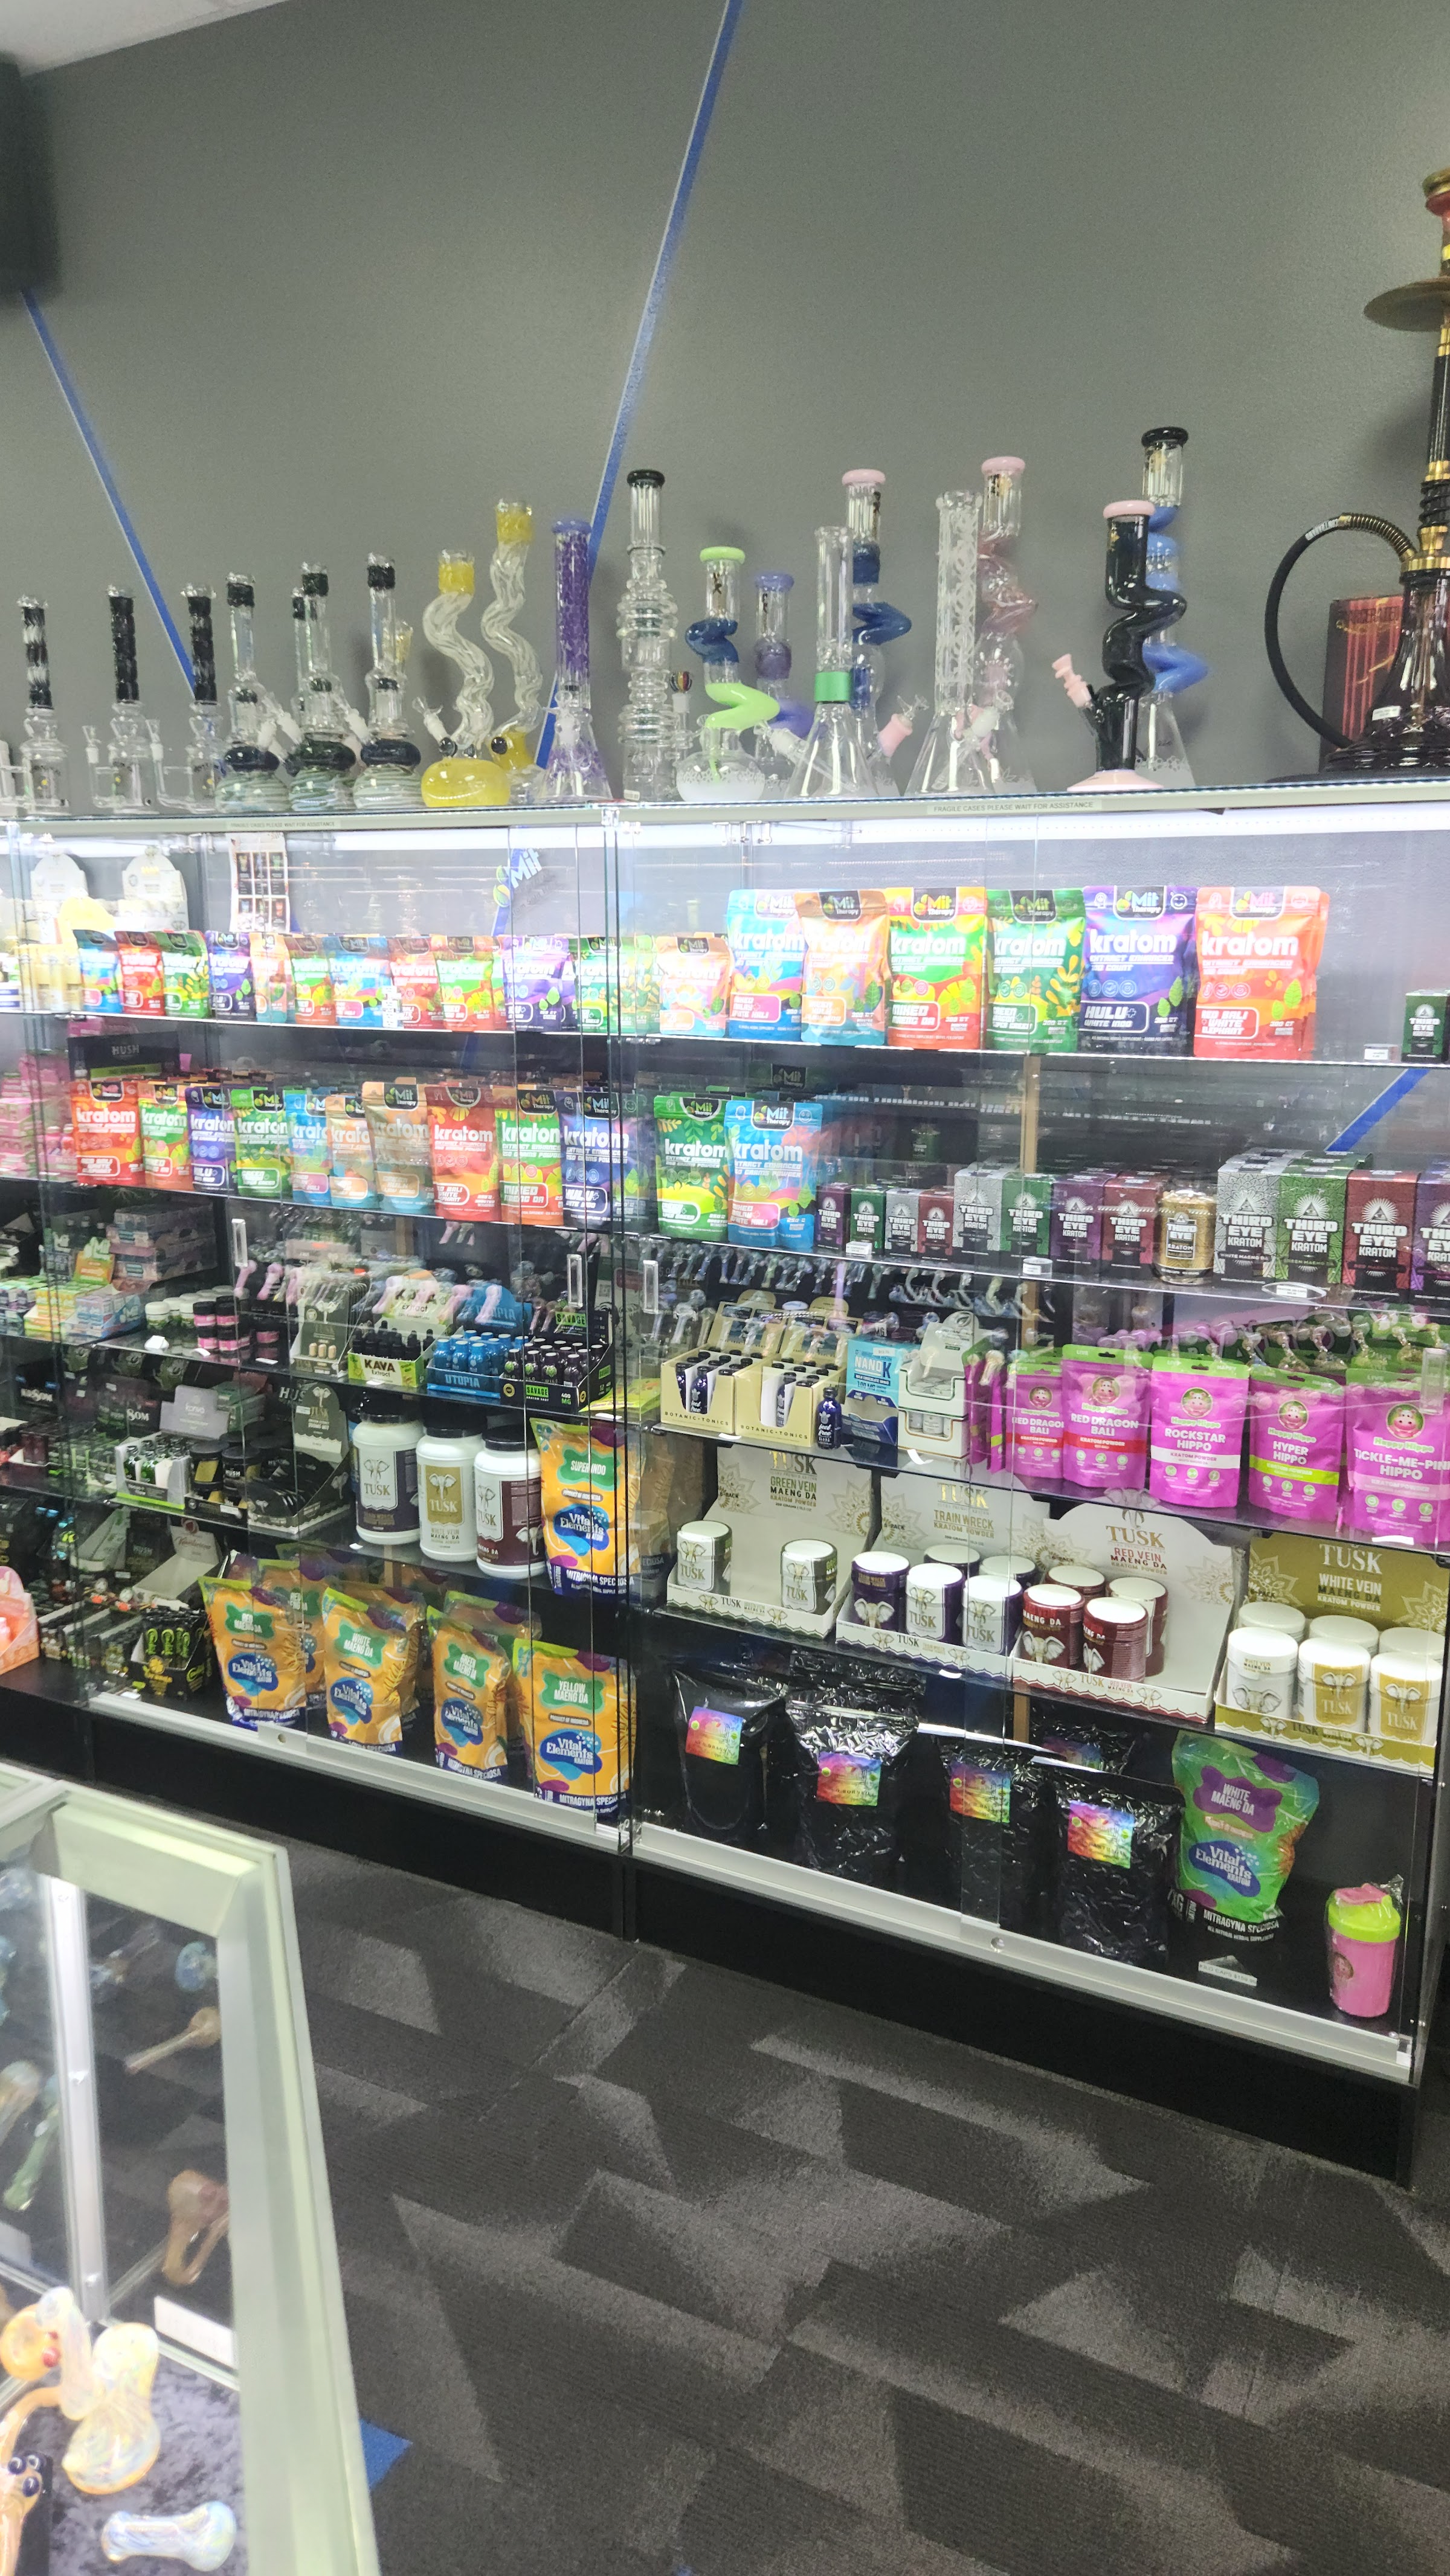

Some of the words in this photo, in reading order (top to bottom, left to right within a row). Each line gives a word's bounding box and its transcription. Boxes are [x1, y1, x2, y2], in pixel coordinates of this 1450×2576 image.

[834, 896, 854, 909] Mit
[928, 895, 952, 910] Mit
[1132, 892, 1159, 906] Mit
[1251, 892, 1275, 906] Mit
[891, 931, 966, 955] kratom
[1090, 929, 1177, 953] kratom
[1202, 931, 1298, 956] kratom
[1202, 1010, 1219, 1019] RED
[112, 1044, 140, 1056] HUSH
[396, 1090, 413, 1100] Mit
[531, 1095, 550, 1106] Mit
[695, 1102, 712, 1113] Mit
[766, 1107, 788, 1120] Mit
[76, 1108, 136, 1124] kratom
[375, 1119, 430, 1139] kratom
[435, 1125, 492, 1142] kratom
[564, 1126, 630, 1148] kratom
[665, 1139, 726, 1157] kratom
[733, 1139, 803, 1161] kratom
[818, 1209, 840, 1218] THIRD
[853, 1213, 879, 1222] THIRD
[959, 1206, 993, 1215] THIRD
[965, 1213, 987, 1222] EYE
[1008, 1209, 1043, 1219] THIRD
[889, 1216, 915, 1225] THIRD
[923, 1220, 950, 1229] THIRD
[1013, 1218, 1037, 1226] EYE
[1058, 1213, 1094, 1224] THIRD
[1110, 1217, 1147, 1227] THIRD
[1222, 1215, 1272, 1227] THIRD
[1284, 1219, 1338, 1232] THIRD
[1063, 1222, 1087, 1230] EYE
[1167, 1224, 1197, 1233] THIRD
[1228, 1226, 1263, 1237] EYE
[1352, 1222, 1408, 1236] THIRD
[1228, 1237, 1262, 1248] KRATOM
[1292, 1230, 1327, 1242] EYE
[1360, 1235, 1397, 1247] EYE
[1291, 1242, 1327, 1253] KRATOM
[1359, 1247, 1396, 1258] KRATOM
[557, 1314, 585, 1325] SAVAGE
[364, 1359, 396, 1372] KAVA
[445, 1373, 480, 1388] UTOPIA
[527, 1386, 548, 1395] SAVAGE
[1071, 1413, 1089, 1424] RED
[1092, 1416, 1138, 1428] DRAGON
[1030, 1426, 1049, 1434] BALI
[1091, 1425, 1114, 1436] BALI
[1165, 1428, 1225, 1444] ROCKSTAR
[1177, 1439, 1211, 1451] HIPPO
[1273, 1441, 1309, 1455] HYPER
[1374, 1437, 1403, 1450] Happy
[1404, 1441, 1434, 1454] Hippo
[769, 1450, 817, 1475] TUSK
[1273, 1450, 1307, 1465] HIPPO
[570, 1460, 590, 1473] SUPER
[1379, 1465, 1423, 1480] HIPPO
[364, 1483, 390, 1495] TUSK
[770, 1476, 796, 1489] GREEN
[799, 1480, 816, 1492] VEIN
[770, 1486, 802, 1497] MAENG
[805, 1492, 816, 1500] DA
[938, 1482, 989, 1509] TUSK
[429, 1499, 458, 1512] TUSK
[478, 1510, 497, 1526] TUSK
[569, 1512, 593, 1526] Vital
[934, 1510, 961, 1524] TRAIN
[963, 1514, 994, 1530] WRECK
[934, 1522, 962, 1532] KRATOM
[1106, 1526, 1165, 1549] TUSK
[1110, 1555, 1148, 1566] MAENG
[1114, 1547, 1133, 1558] RED
[1138, 1550, 1161, 1563] VEIN
[1319, 1544, 1382, 1575] TUSK
[680, 1564, 705, 1580] TUSK
[1319, 1573, 1353, 1590] WHITE
[1356, 1579, 1382, 1595] VEIN
[786, 1584, 807, 1601] TUSK
[1318, 1585, 1360, 1598] MAENG
[1365, 1593, 1380, 1604] DA
[721, 1597, 741, 1608] TUSK
[1317, 1595, 1348, 1606] KRATOM
[1350, 1600, 1381, 1612] POWDER
[909, 1611, 936, 1628] TUSK
[352, 1633, 371, 1645] WHITE
[968, 1625, 994, 1642] TUSK
[344, 1640, 364, 1656] MAENG
[897, 1634, 920, 1648] TUSK
[460, 1653, 477, 1666] GREEN
[559, 1680, 585, 1694] YELLOW
[1080, 1674, 1104, 1687] TUSK
[555, 1690, 576, 1703] MAENG
[579, 1694, 588, 1704] DA
[451, 1705, 470, 1721] Vital
[1322, 1699, 1352, 1715] TUSK
[445, 1710, 478, 1732] Elements
[1387, 1713, 1417, 1730] TUSK
[1292, 1723, 1318, 1736] TUSK
[547, 1742, 593, 1759] Elements
[558, 1737, 582, 1750] Vital
[1224, 1784, 1250, 1801] WHITE
[560, 1794, 593, 1806] MITRAGYNA
[1211, 1791, 1242, 1810] MAENG
[1243, 1804, 1254, 1816] DA
[1210, 1846, 1240, 1862] Vital
[1196, 1848, 1252, 1880] Elements
[1228, 1873, 1251, 1887] KRATOM
[1204, 1909, 1246, 1932] MITRAGYNA
